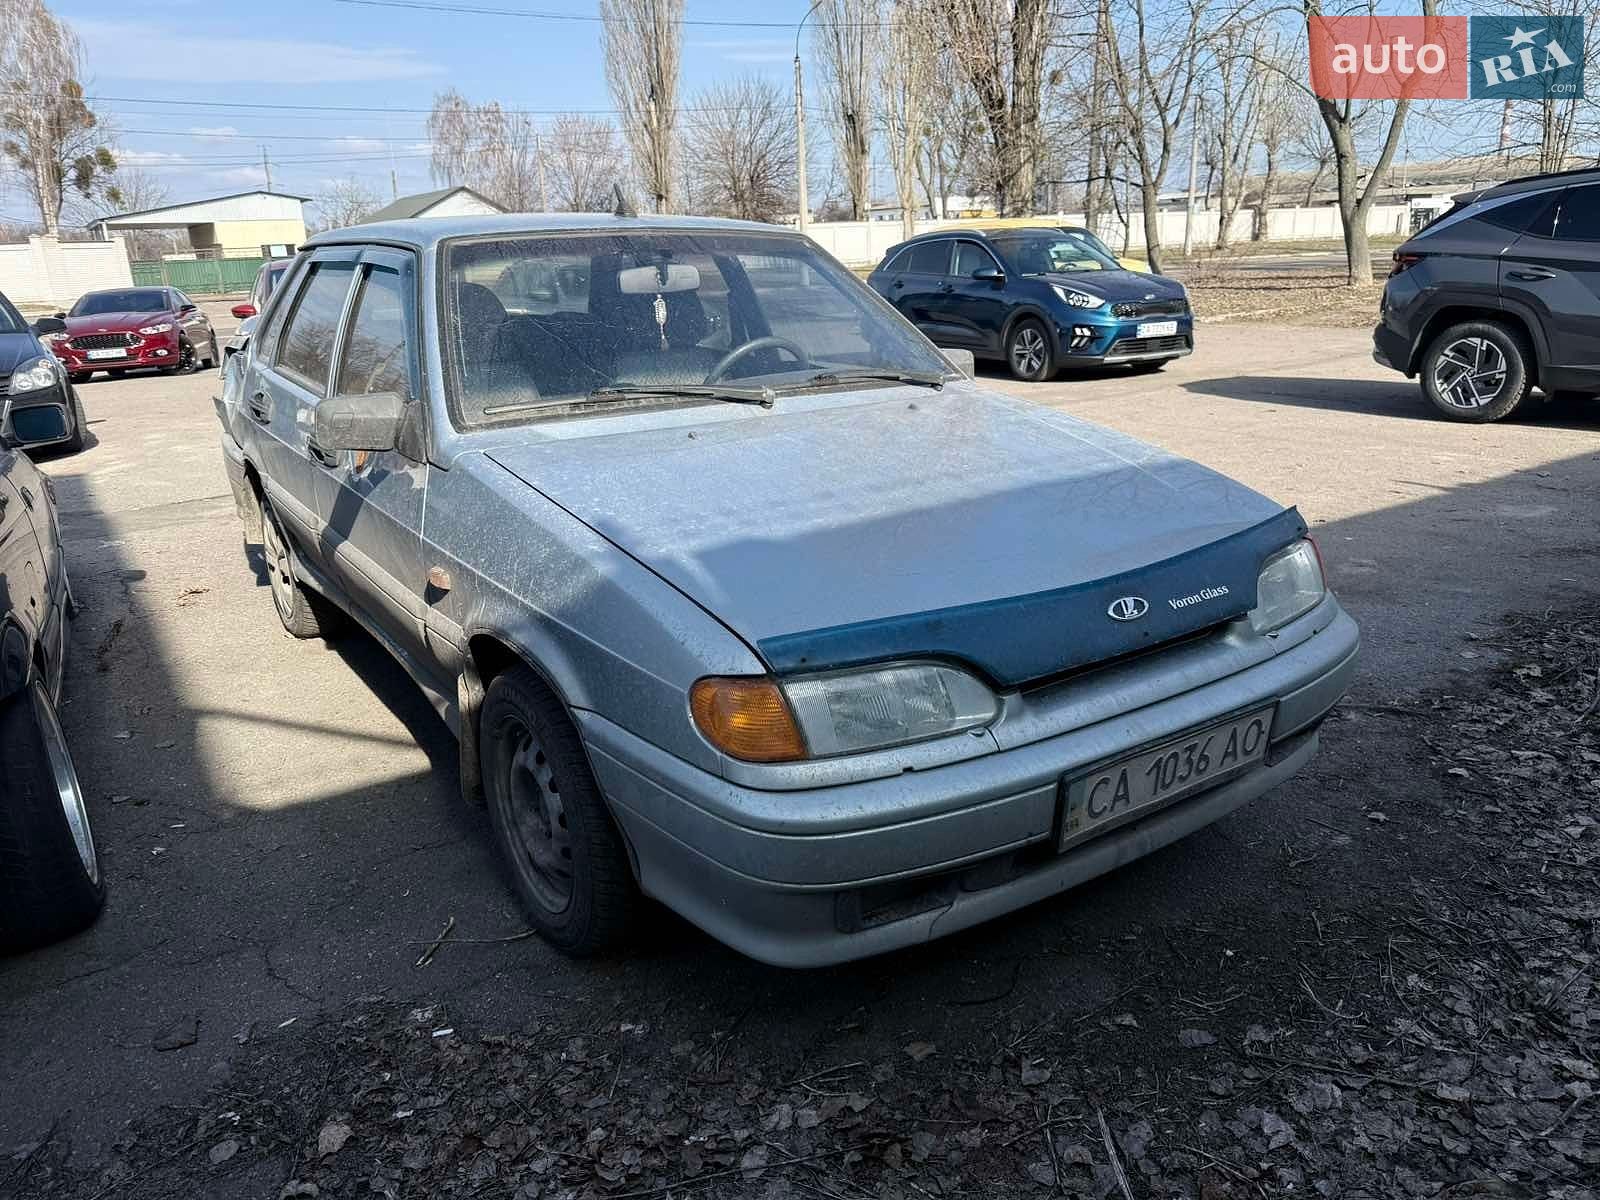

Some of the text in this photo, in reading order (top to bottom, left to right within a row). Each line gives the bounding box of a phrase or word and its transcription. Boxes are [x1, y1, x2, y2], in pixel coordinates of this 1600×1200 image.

[1168, 585, 1229, 610] Voron Glass
[1088, 719, 1264, 819] CA 1036 AO
